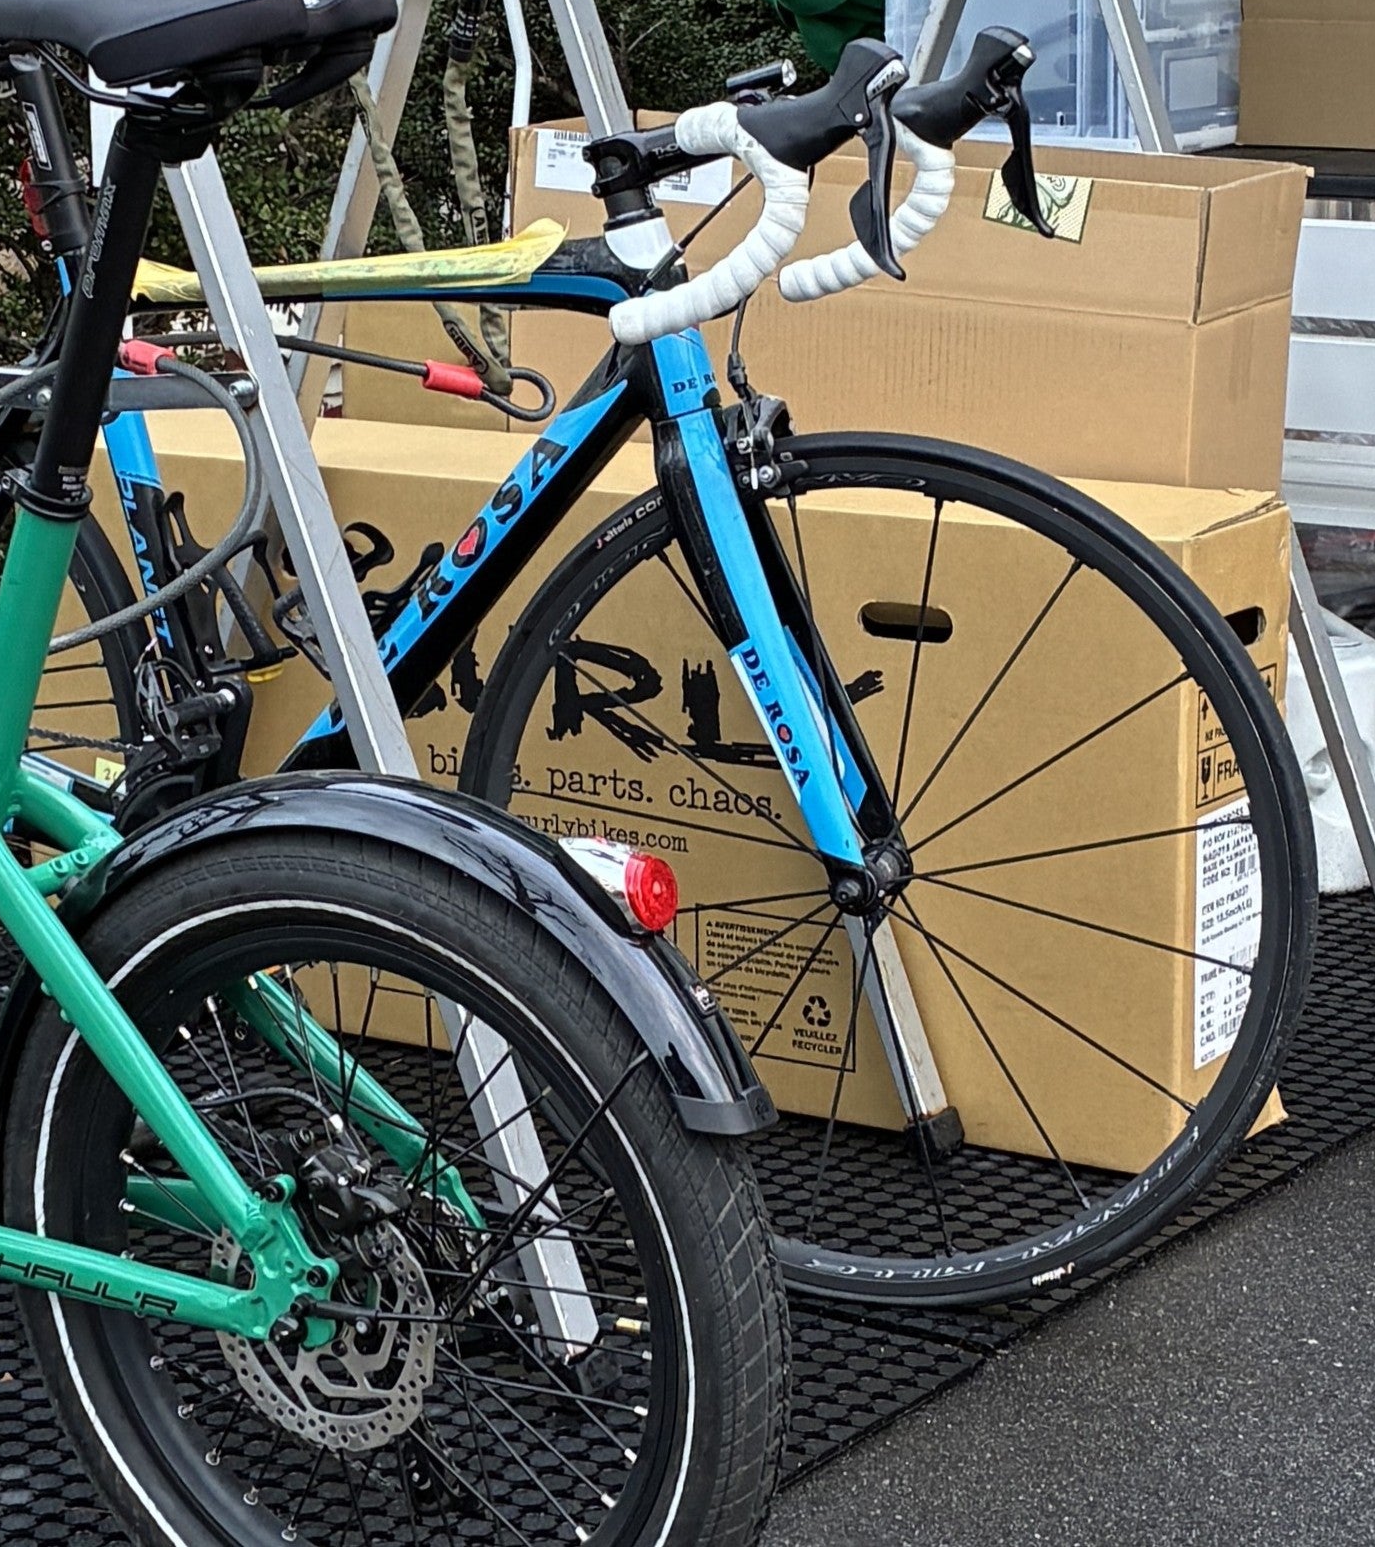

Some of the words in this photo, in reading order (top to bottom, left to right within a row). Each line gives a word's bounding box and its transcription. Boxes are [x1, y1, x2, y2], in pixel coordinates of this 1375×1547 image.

[672, 376, 698, 395] DE
[418, 438, 570, 622] ROSA
[740, 645, 771, 692] DE
[764, 700, 811, 790] ROSA
[546, 765, 654, 804] parts.
[669, 777, 782, 821] chaos.
